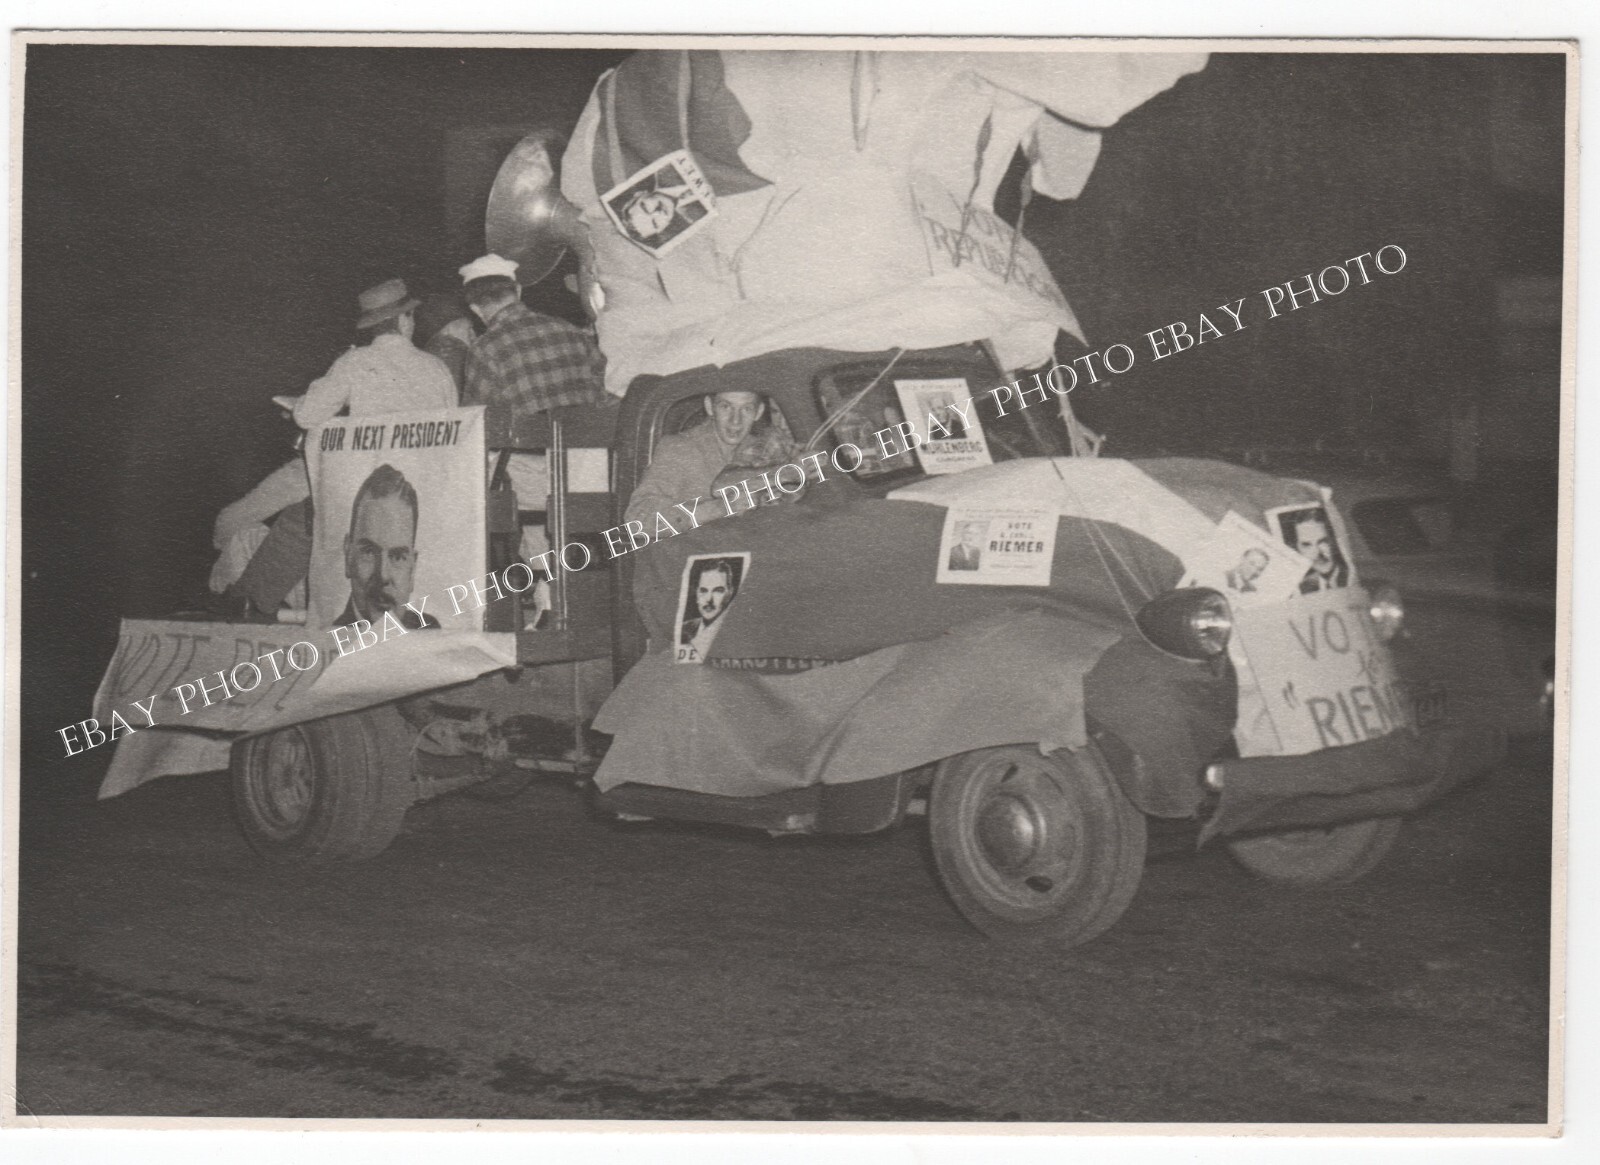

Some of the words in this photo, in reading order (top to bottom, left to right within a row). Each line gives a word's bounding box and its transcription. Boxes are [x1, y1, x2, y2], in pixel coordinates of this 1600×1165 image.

[320, 426, 346, 451] OUR
[351, 425, 386, 450] NEXT
[390, 420, 462, 449] PRESIDENT
[989, 540, 1044, 553] RIEMER
